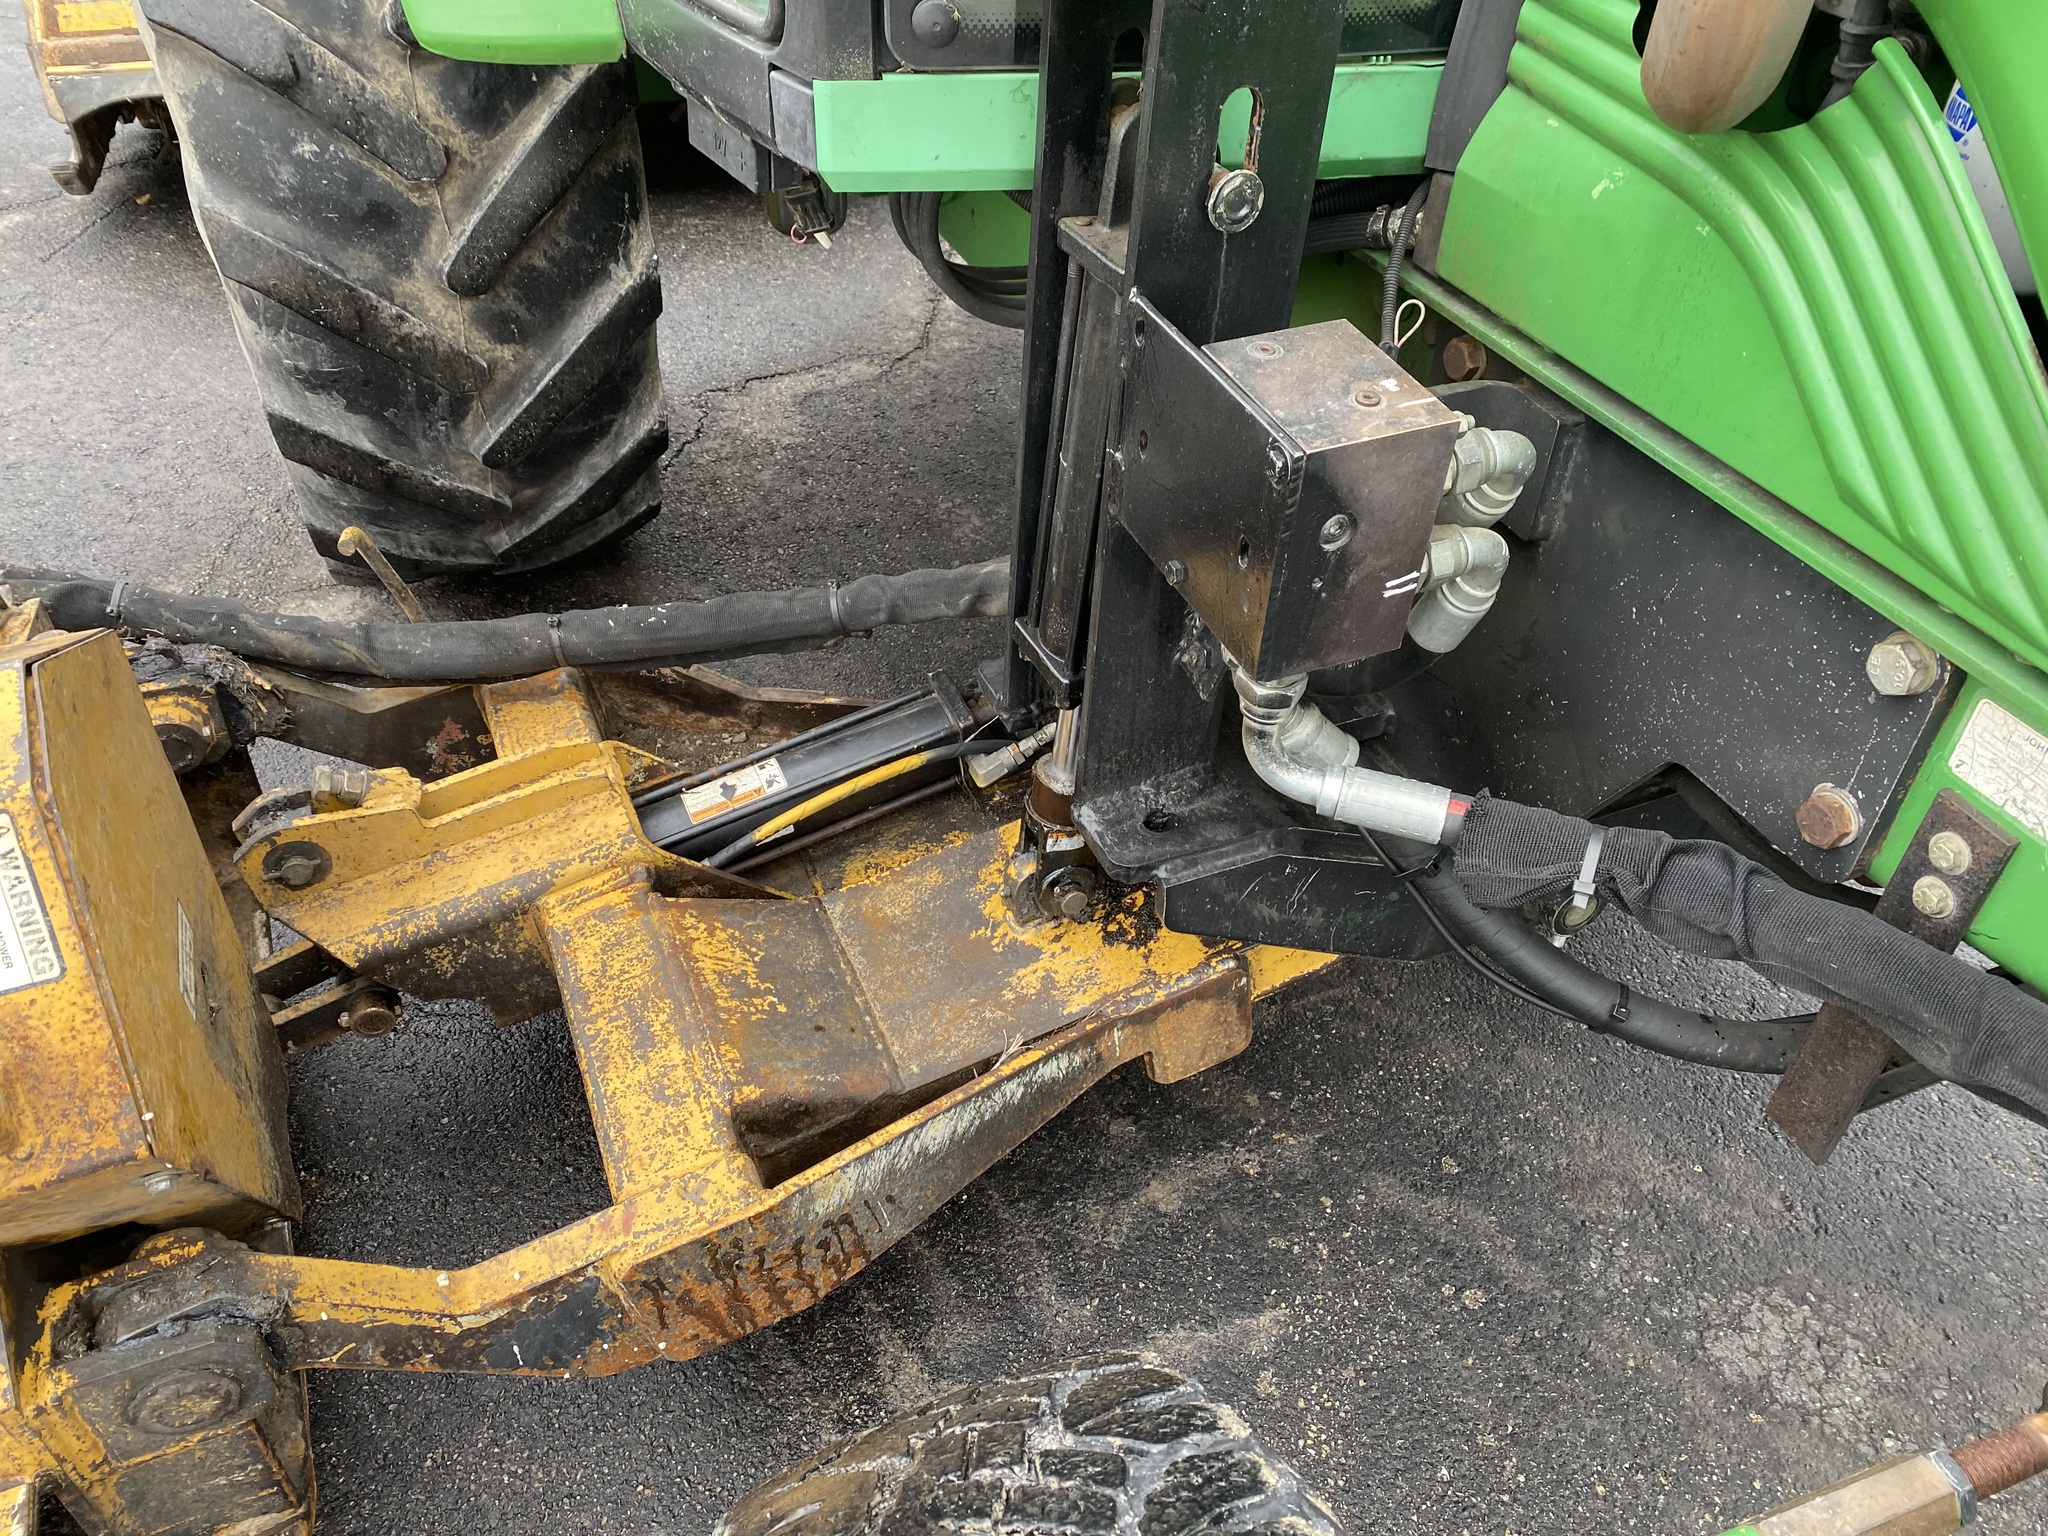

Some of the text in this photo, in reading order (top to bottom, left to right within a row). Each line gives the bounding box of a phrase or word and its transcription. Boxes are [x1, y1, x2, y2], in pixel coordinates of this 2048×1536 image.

[1946, 96, 1972, 131] NAPA
[1893, 659, 1905, 687] 10.9
[0, 847, 54, 975] WARNING
